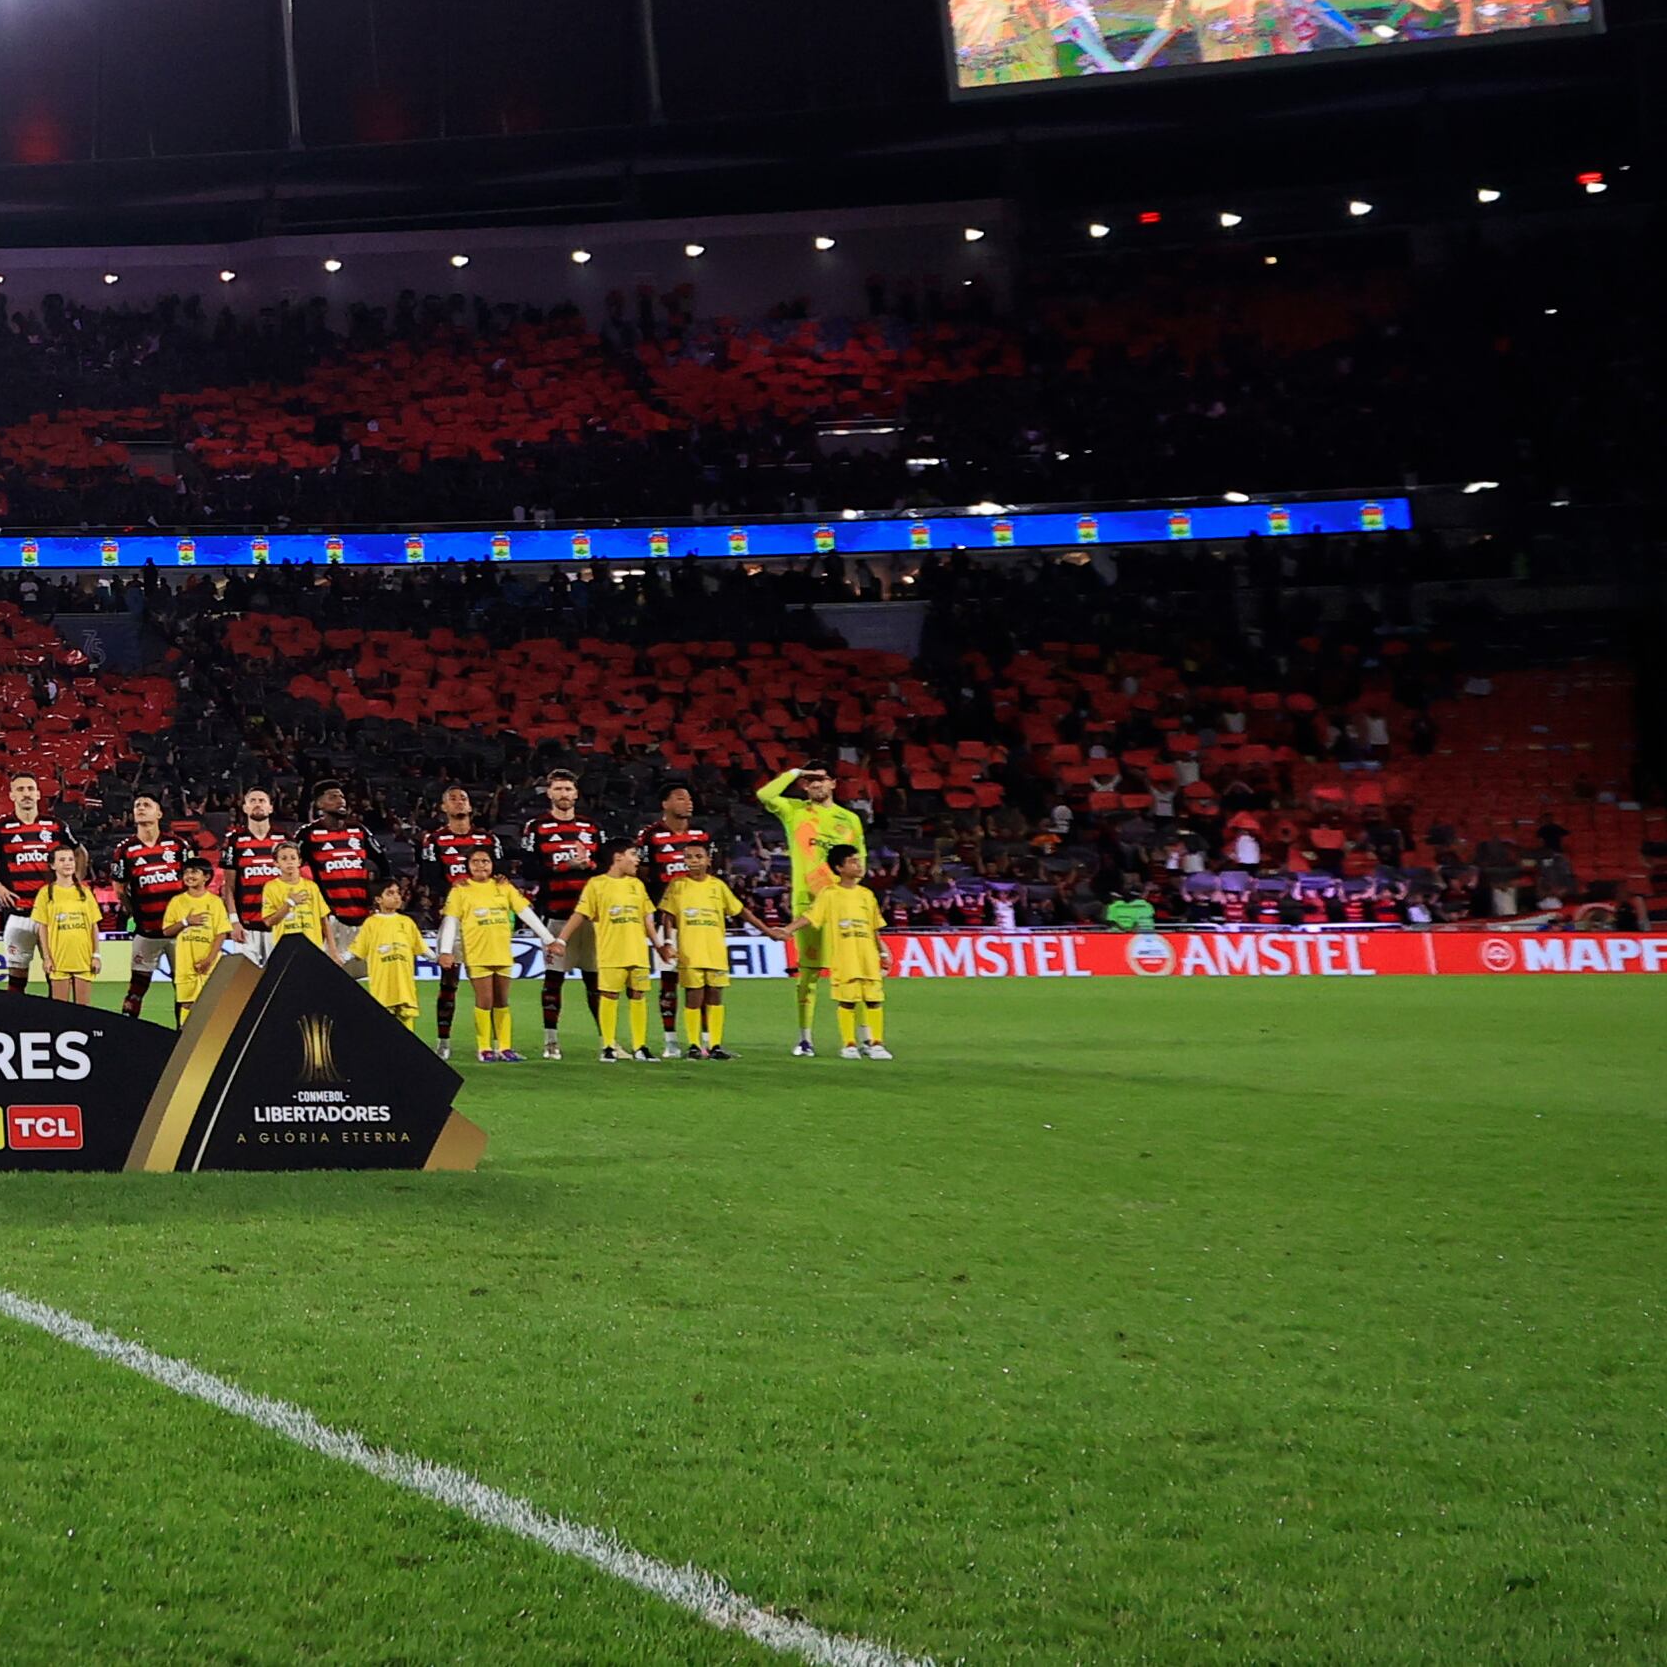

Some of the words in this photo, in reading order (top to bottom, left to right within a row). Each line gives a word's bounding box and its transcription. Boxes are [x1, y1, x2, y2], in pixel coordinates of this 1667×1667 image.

[325, 857, 364, 873] pixbet
[139, 869, 178, 888] pixbet
[298, 1091, 346, 1103] CONMEBOL
[254, 1105, 391, 1123] LIBERTADORES
[14, 1117, 76, 1138] TCL
[237, 1133, 247, 1143] A
[259, 1129, 330, 1143] GLÓRIA
[342, 1131, 411, 1143] ETERNA
